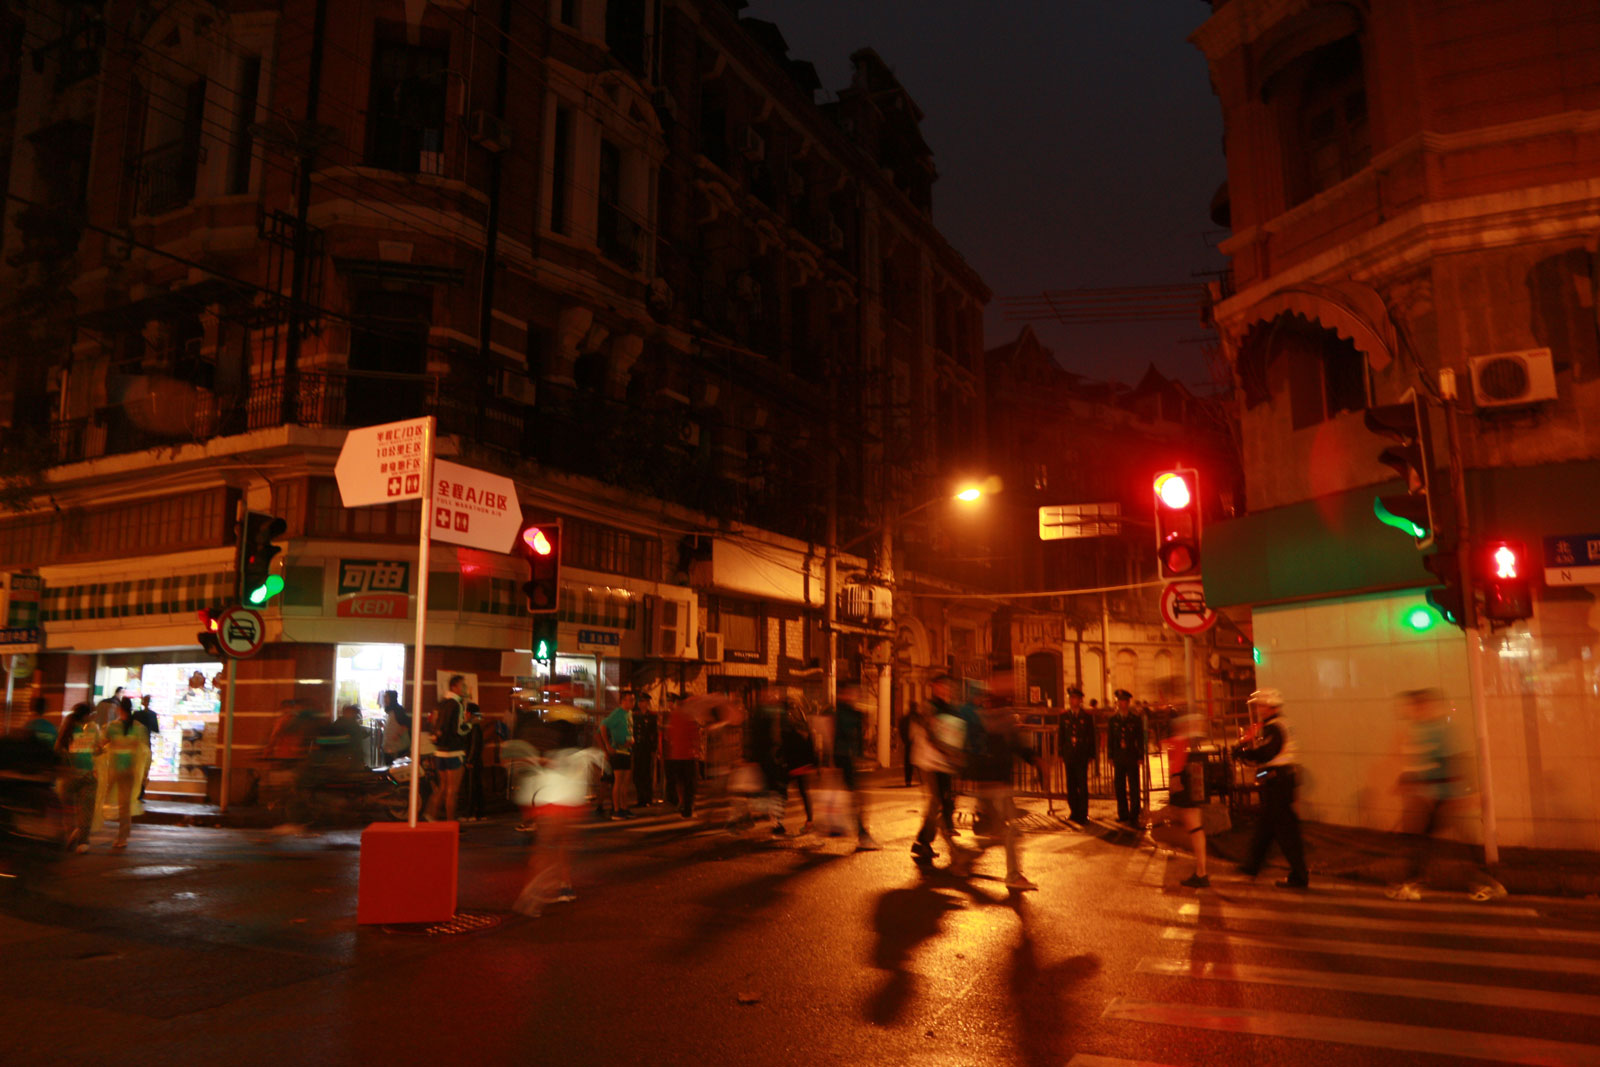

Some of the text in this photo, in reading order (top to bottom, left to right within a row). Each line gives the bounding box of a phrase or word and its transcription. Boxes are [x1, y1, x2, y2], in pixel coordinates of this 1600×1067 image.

[438, 480, 508, 511] 全程A/B区
[342, 562, 406, 593] 可的
[1560, 570, 1572, 582] N
[350, 599, 395, 615] KEDI
